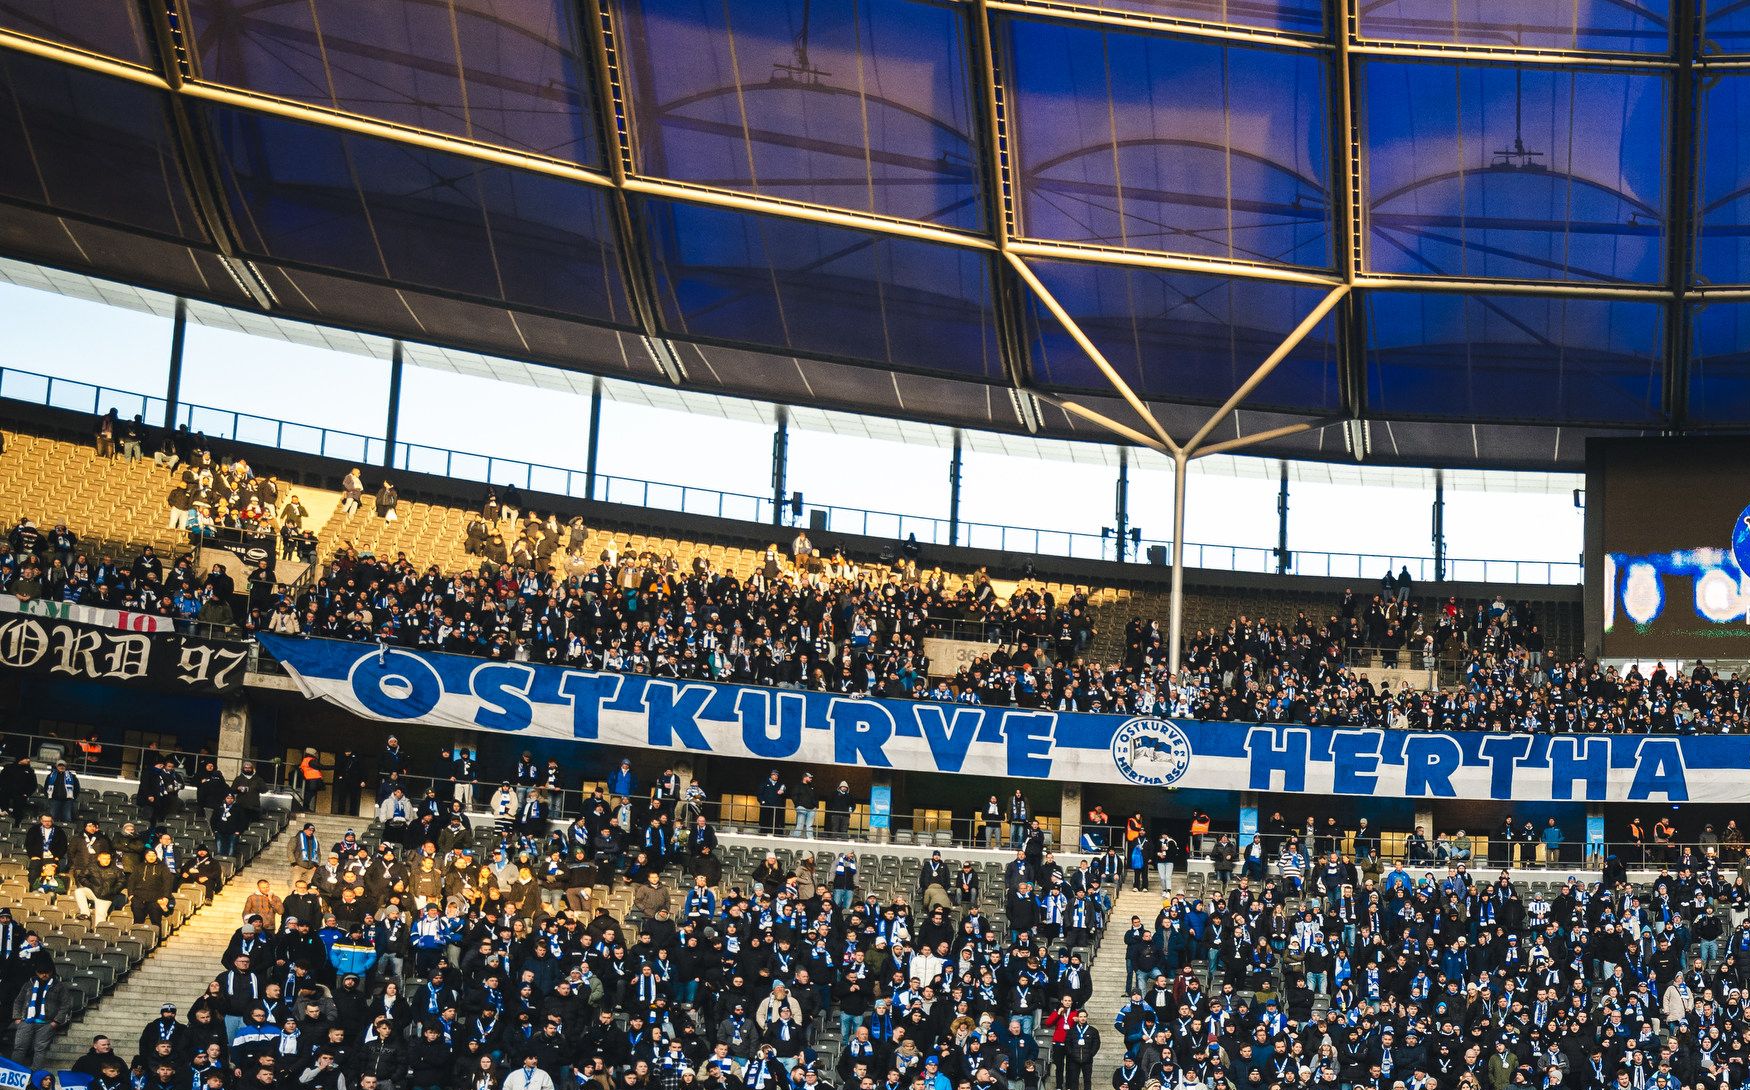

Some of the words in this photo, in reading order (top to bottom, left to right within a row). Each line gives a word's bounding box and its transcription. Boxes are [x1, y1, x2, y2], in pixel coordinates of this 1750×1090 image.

[956, 649, 977, 662] 36
[348, 649, 1057, 779] OSTKURVE
[1243, 727, 1691, 802] HERTHA
[1120, 721, 1184, 746] OSTKURVE
[1118, 757, 1163, 784] HERTHA
[1165, 761, 1185, 782] BSC
